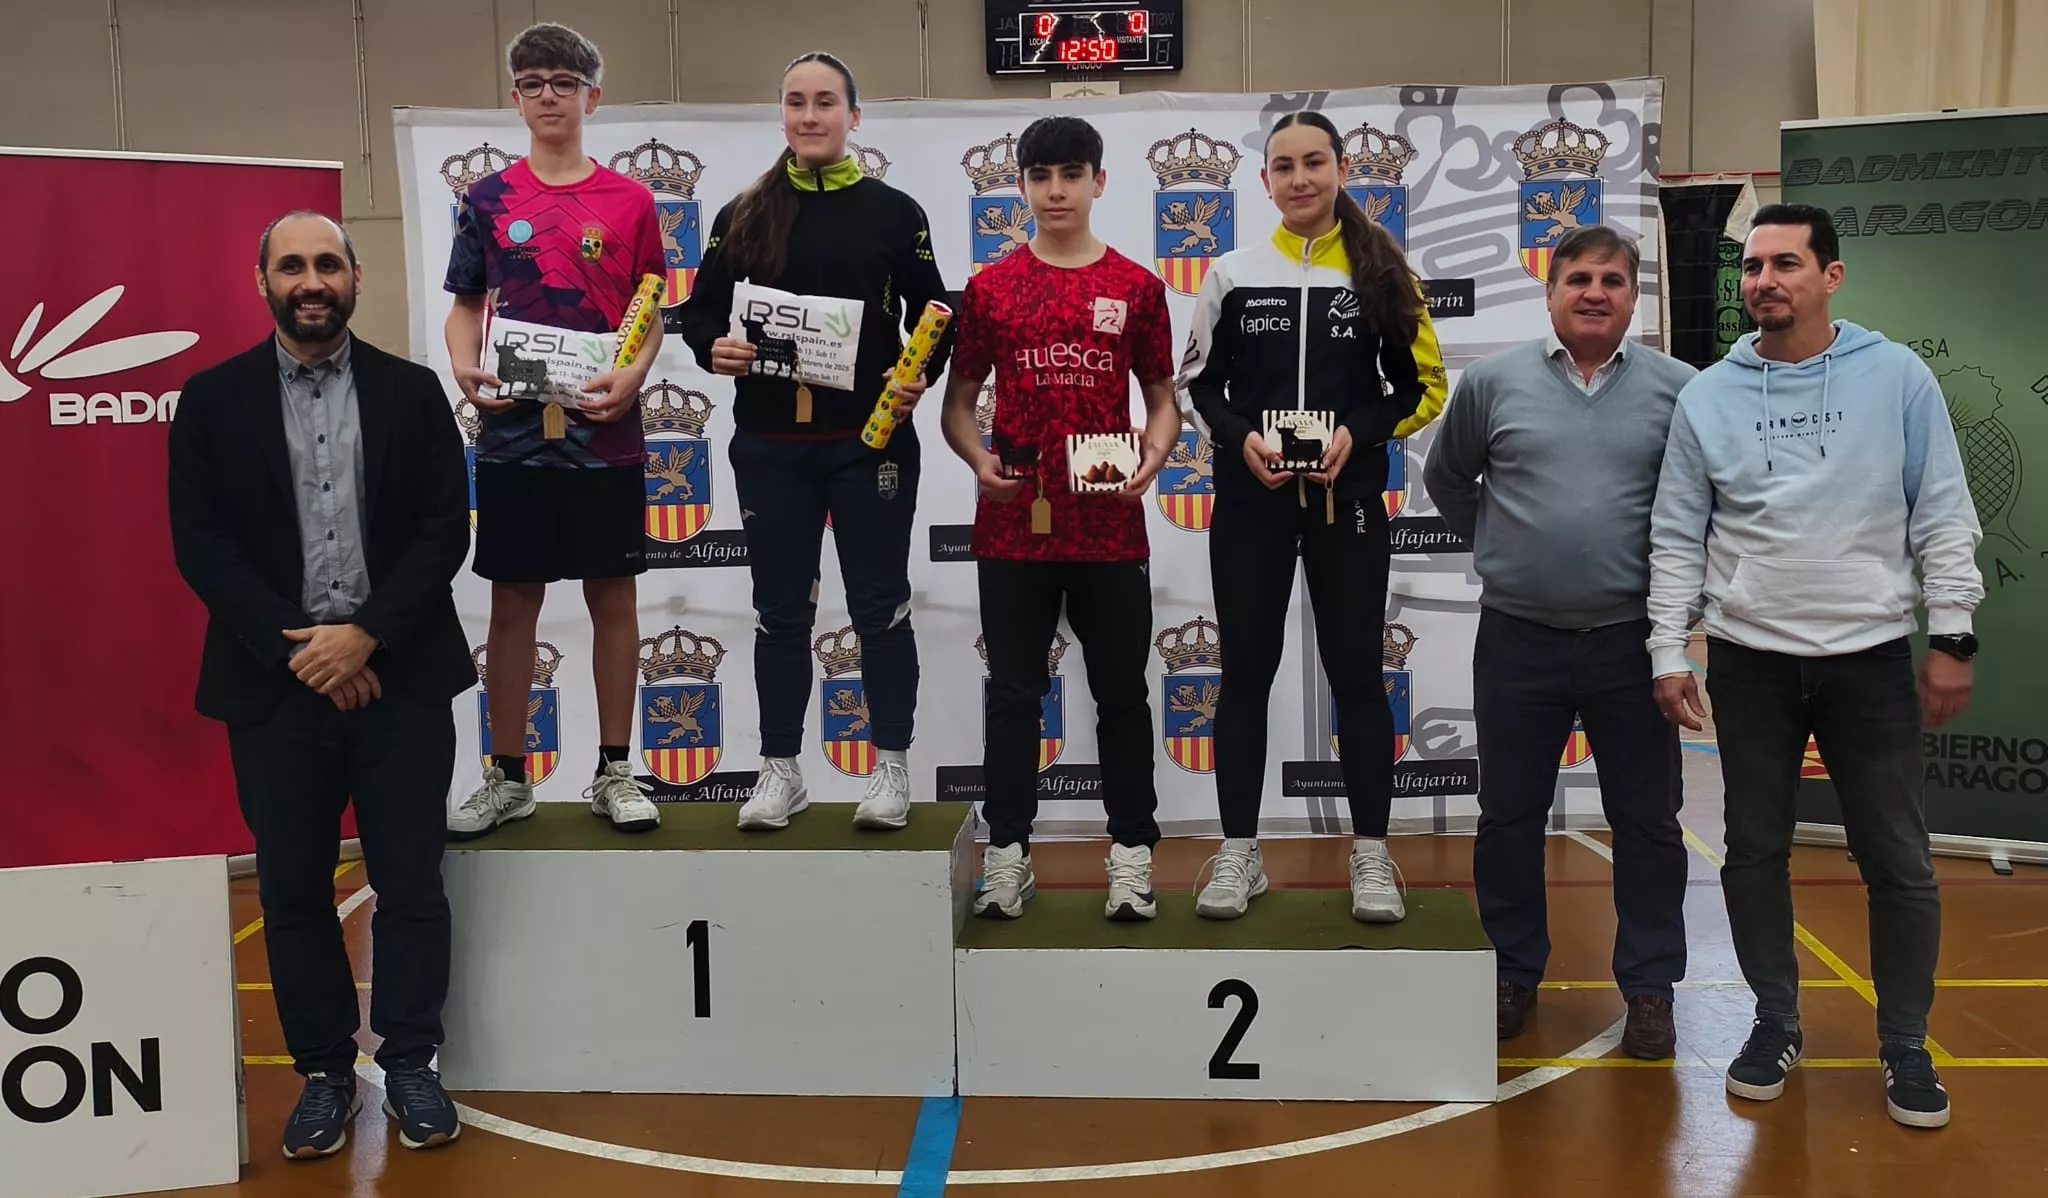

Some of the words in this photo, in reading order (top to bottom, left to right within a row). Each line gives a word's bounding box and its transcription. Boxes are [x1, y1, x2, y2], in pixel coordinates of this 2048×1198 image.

[1060, 39, 1115, 60] 12:50
[1783, 147, 2048, 187] BADMINT
[502, 330, 578, 358] RSL
[746, 299, 821, 333] RSL
[0, 956, 83, 1034] O
[686, 920, 711, 1018] 1
[1207, 978, 1260, 1080] 2
[1, 1037, 162, 1124] ON
